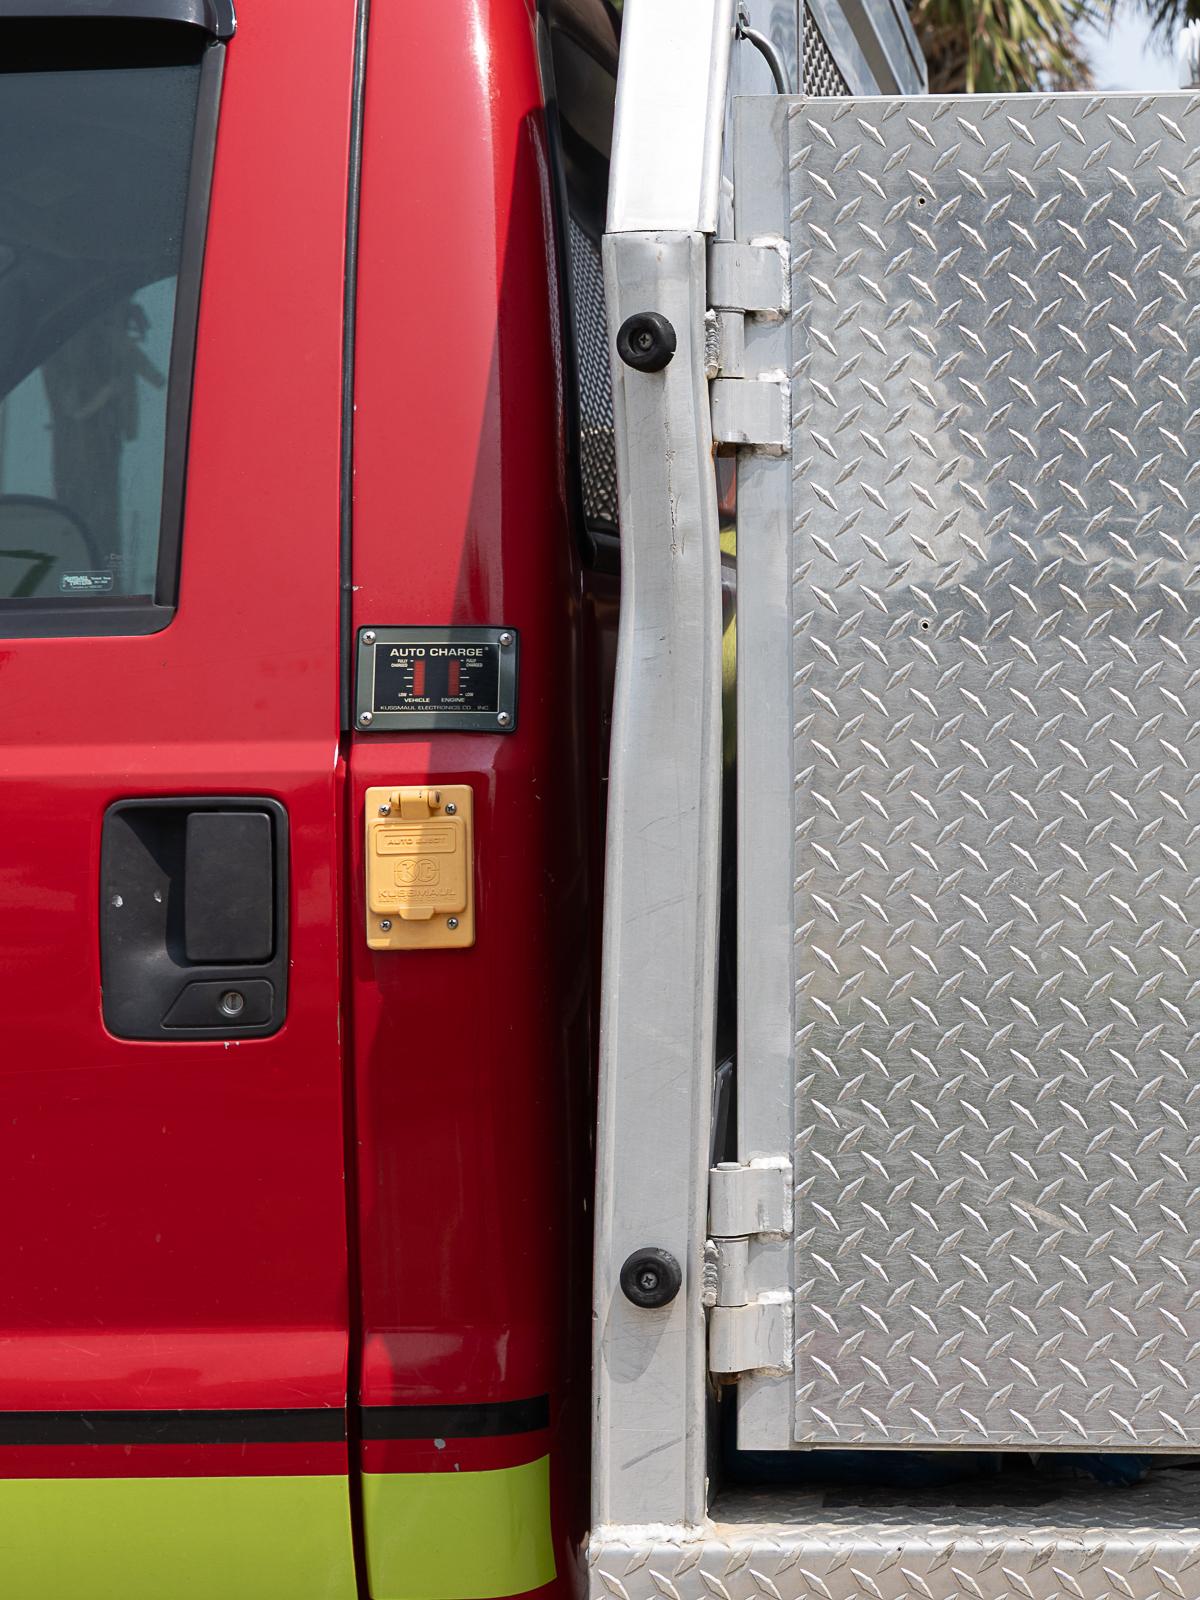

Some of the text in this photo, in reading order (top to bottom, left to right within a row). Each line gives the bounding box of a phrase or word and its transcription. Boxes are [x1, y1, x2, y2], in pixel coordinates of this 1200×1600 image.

[390, 648, 483, 657] AUTO CHARGE
[387, 838, 413, 846] AUTO
